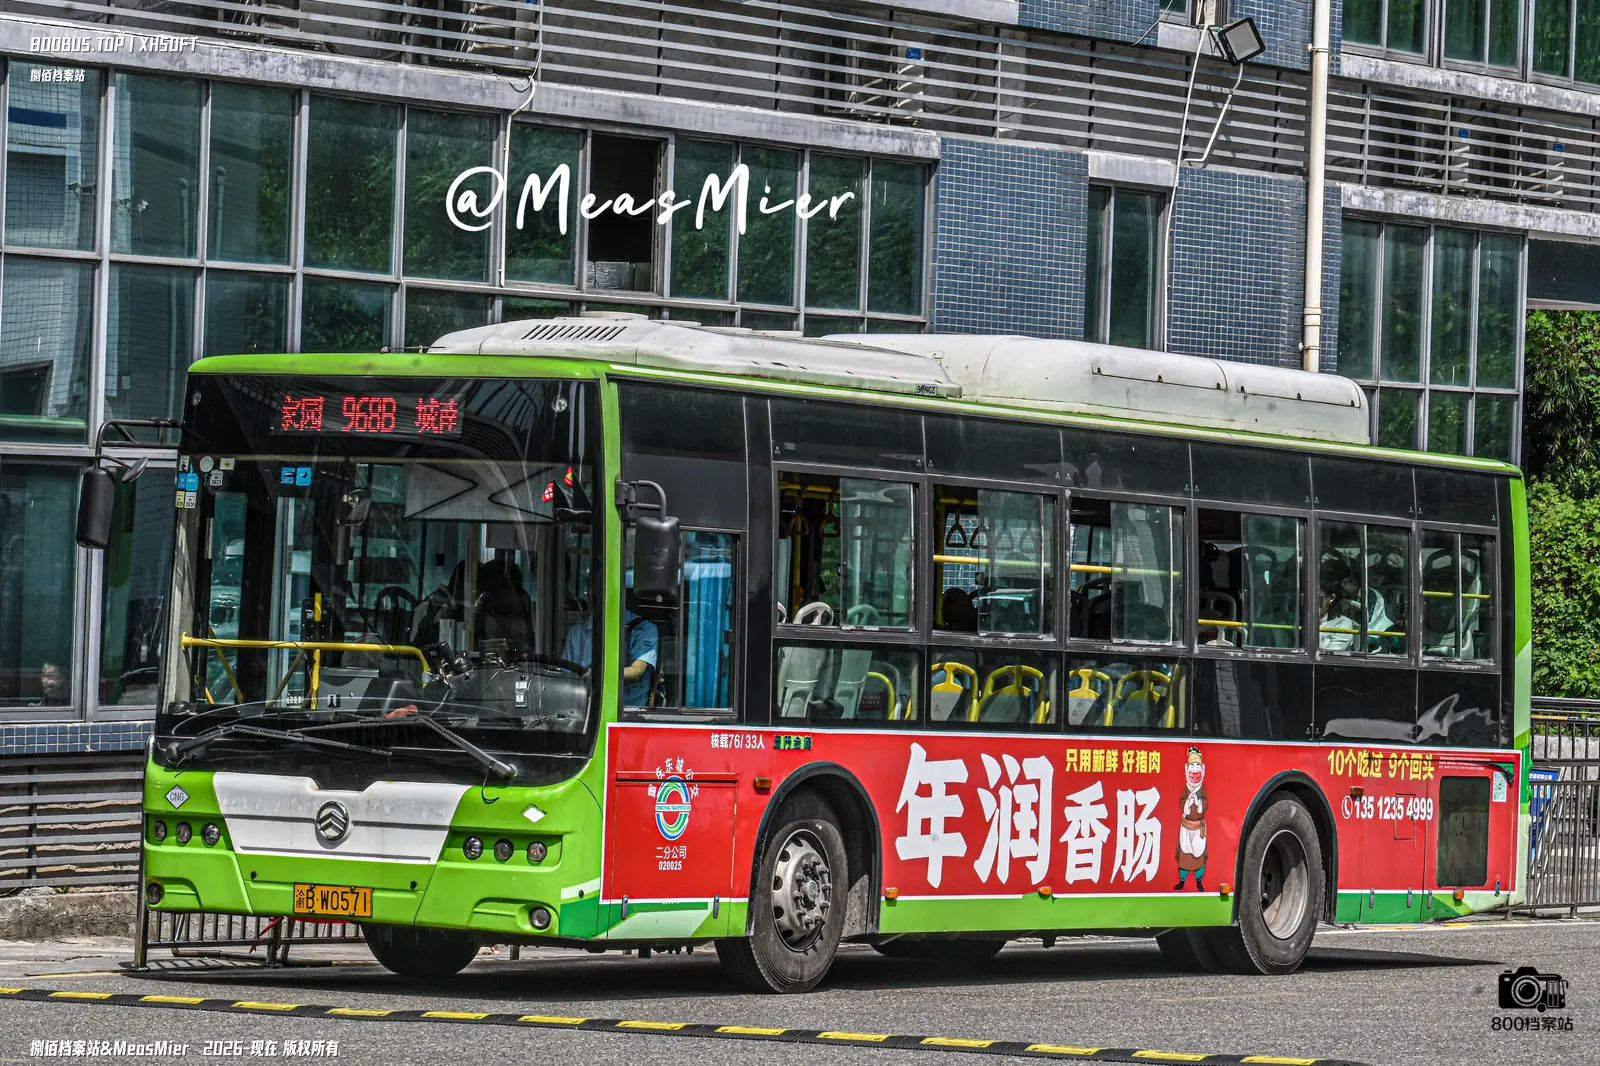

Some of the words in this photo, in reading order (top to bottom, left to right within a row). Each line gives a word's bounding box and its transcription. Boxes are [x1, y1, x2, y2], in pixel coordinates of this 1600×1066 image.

[414, 397, 458, 434] 城南
[1065, 749, 1118, 773] 只用新鲜
[1122, 749, 1161, 773] 好猪肉
[1328, 749, 1384, 778] 10个吃过
[1388, 752, 1434, 780] 9个回头
[170, 792, 185, 801] CNG
[1354, 795, 1375, 819] 135
[1377, 796, 1405, 820] 1235
[1406, 797, 1434, 821] 4999
[895, 742, 1162, 888] 年润香肠
[655, 845, 687, 859] 二分公司
[658, 860, 683, 871] 020025
